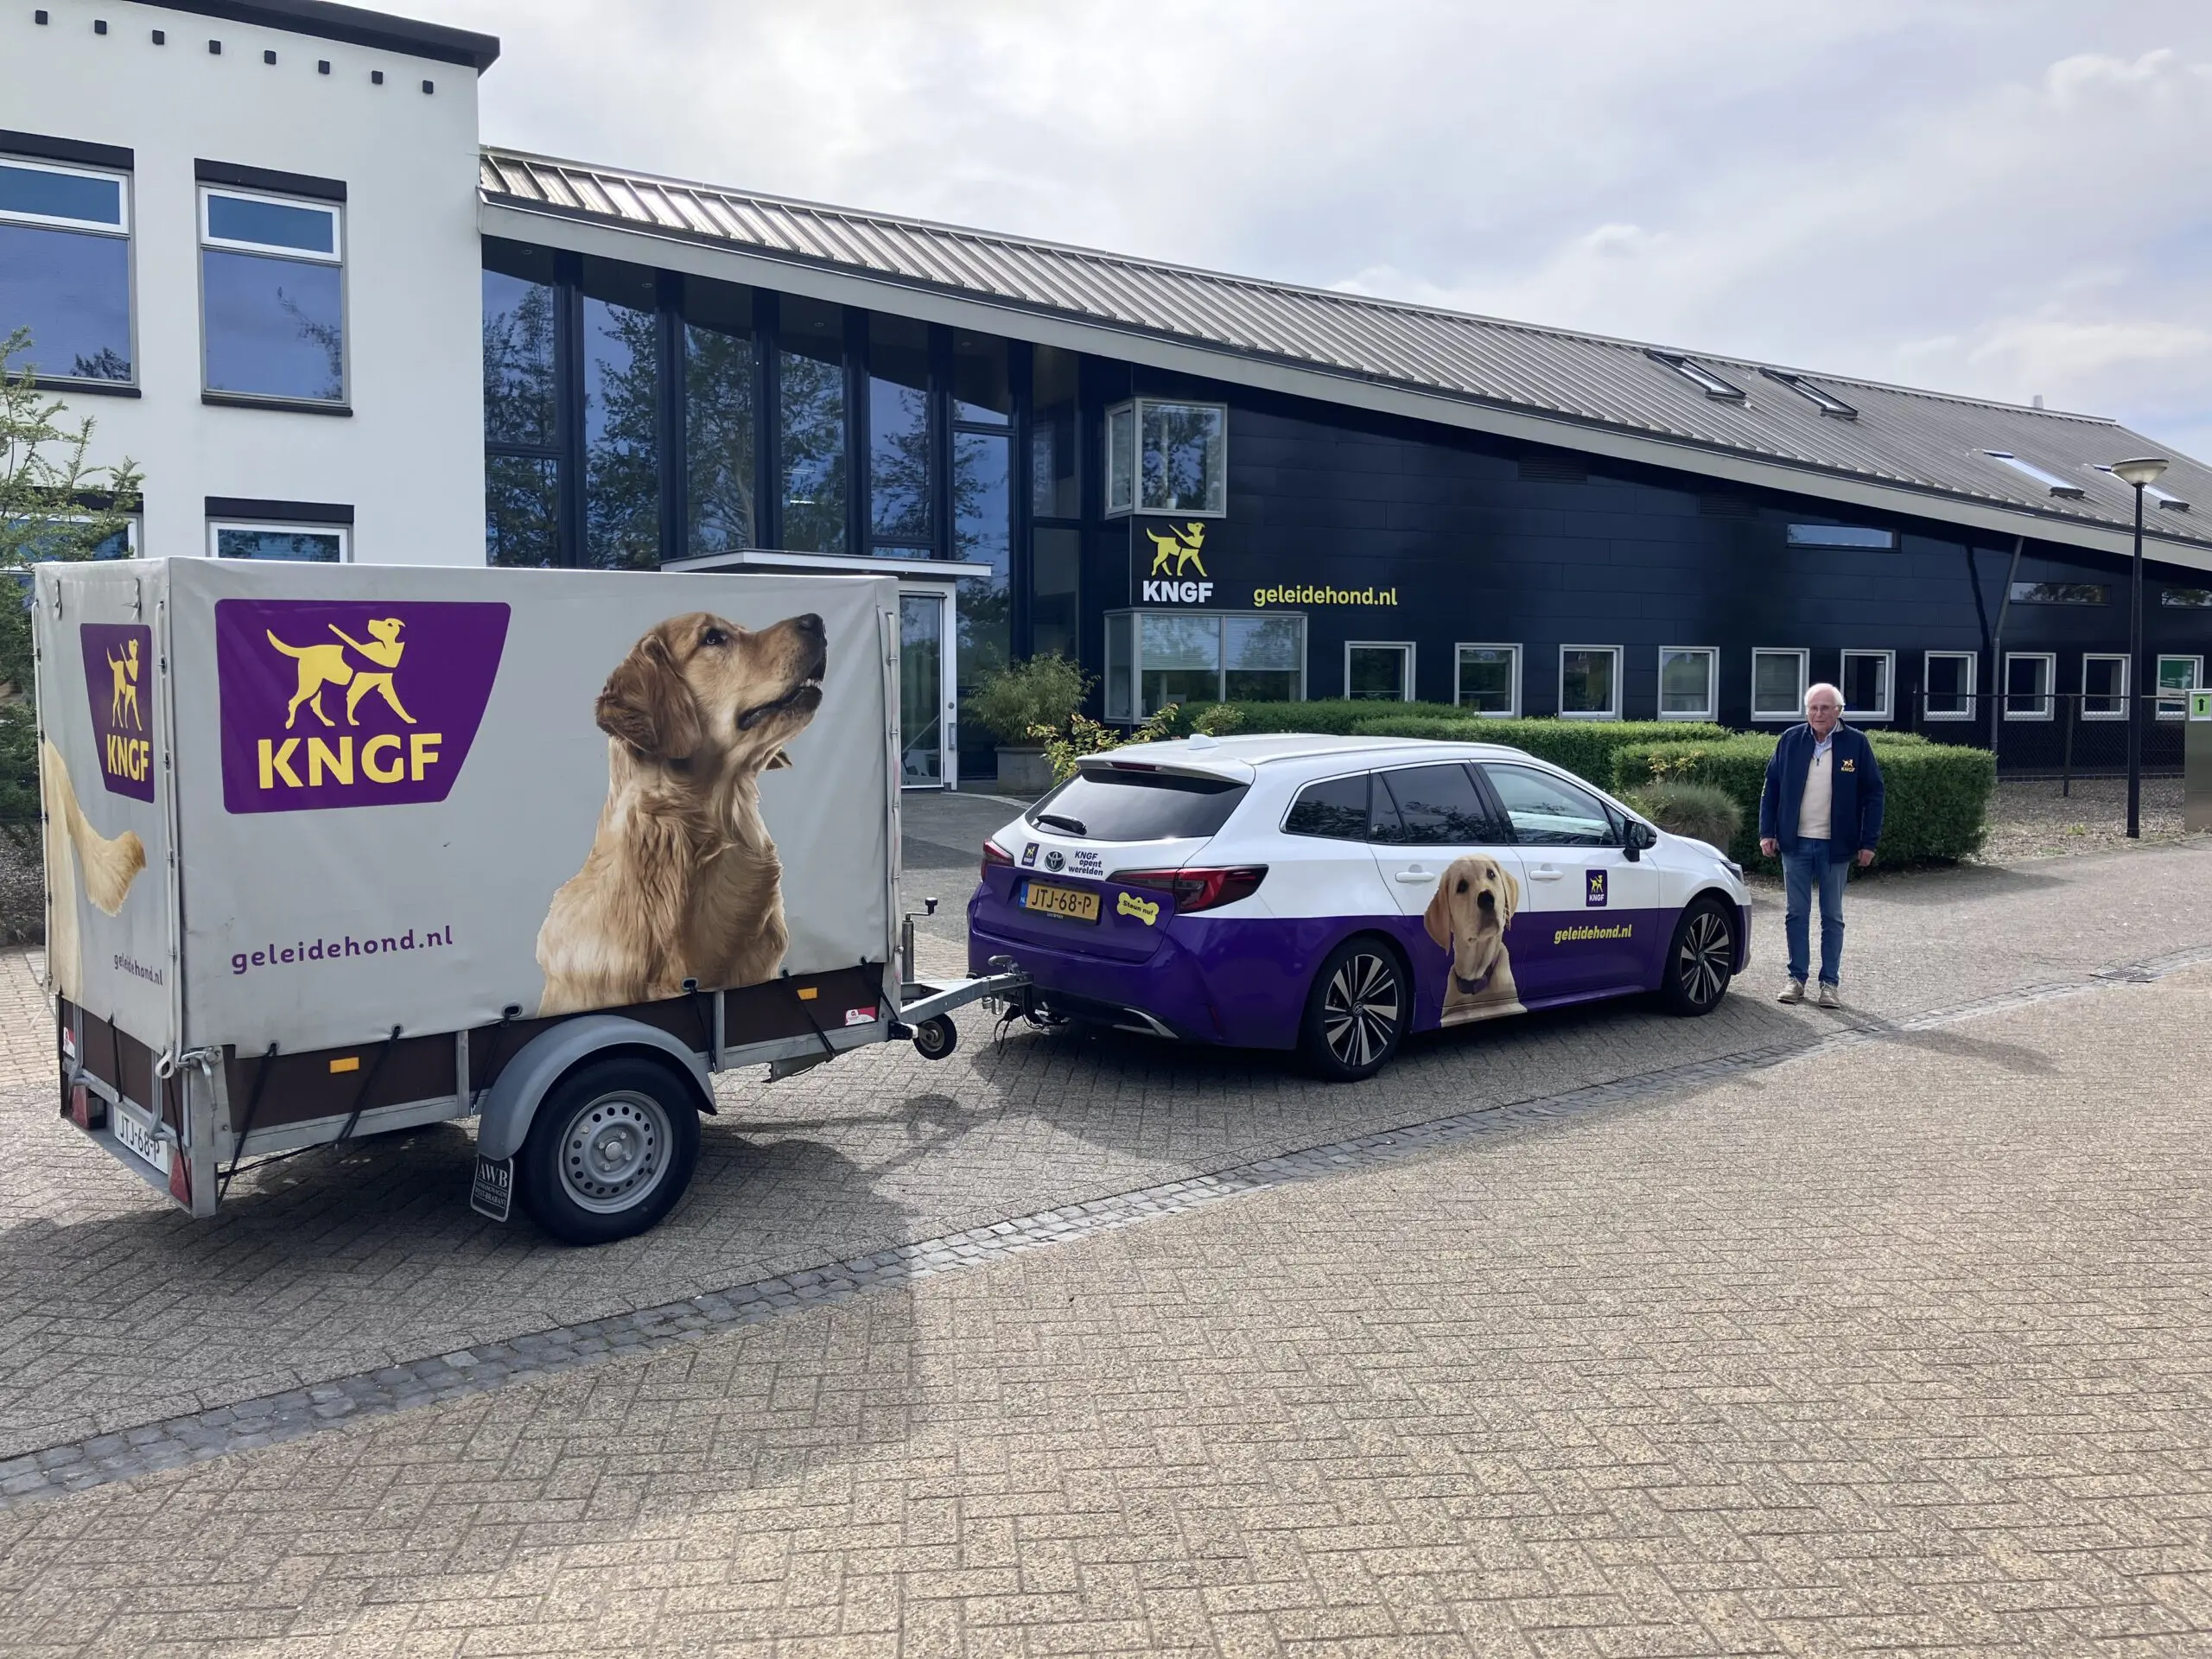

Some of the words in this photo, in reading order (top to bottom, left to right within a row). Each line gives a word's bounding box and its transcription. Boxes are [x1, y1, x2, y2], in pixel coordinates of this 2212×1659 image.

[1142, 581, 1213, 603] KNGF
[1253, 585, 1397, 607] geleidehond.nl
[107, 734, 149, 782] KNGF
[258, 733, 442, 788] KNGF
[1075, 850, 1098, 861] KNGF
[1079, 859, 1102, 868] opent
[1068, 866, 1103, 876] werelden
[1032, 888, 1092, 914] JTJ-68-P
[1123, 900, 1141, 912] Steun
[1554, 924, 1632, 944] geleidehond.nl
[232, 925, 453, 975] geleidehond.nl
[114, 952, 163, 986] geleidehond.nl
[120, 1115, 160, 1162] JTJ-68-P
[478, 1162, 508, 1188] AWB
